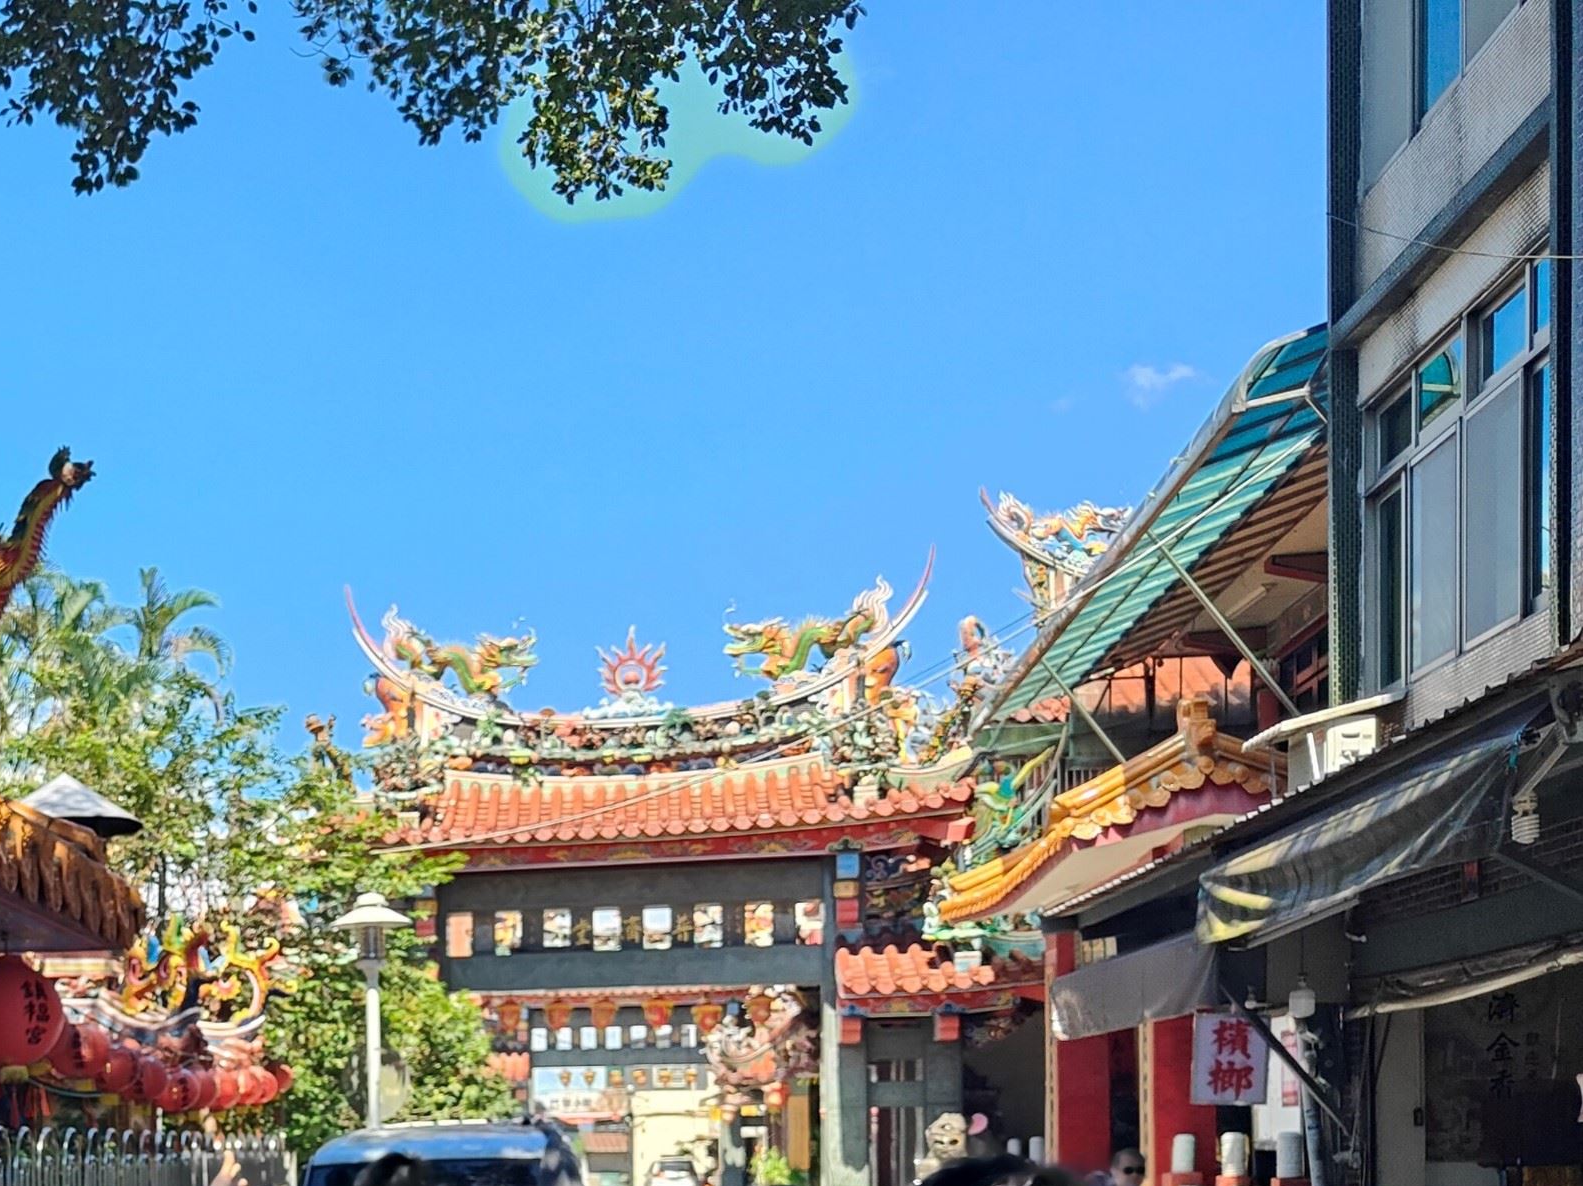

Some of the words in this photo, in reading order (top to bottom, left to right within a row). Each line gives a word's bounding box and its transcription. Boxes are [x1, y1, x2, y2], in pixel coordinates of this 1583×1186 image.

[21, 979, 51, 1045] 鎮福宮
[1207, 1018, 1254, 1101] 檳榔
